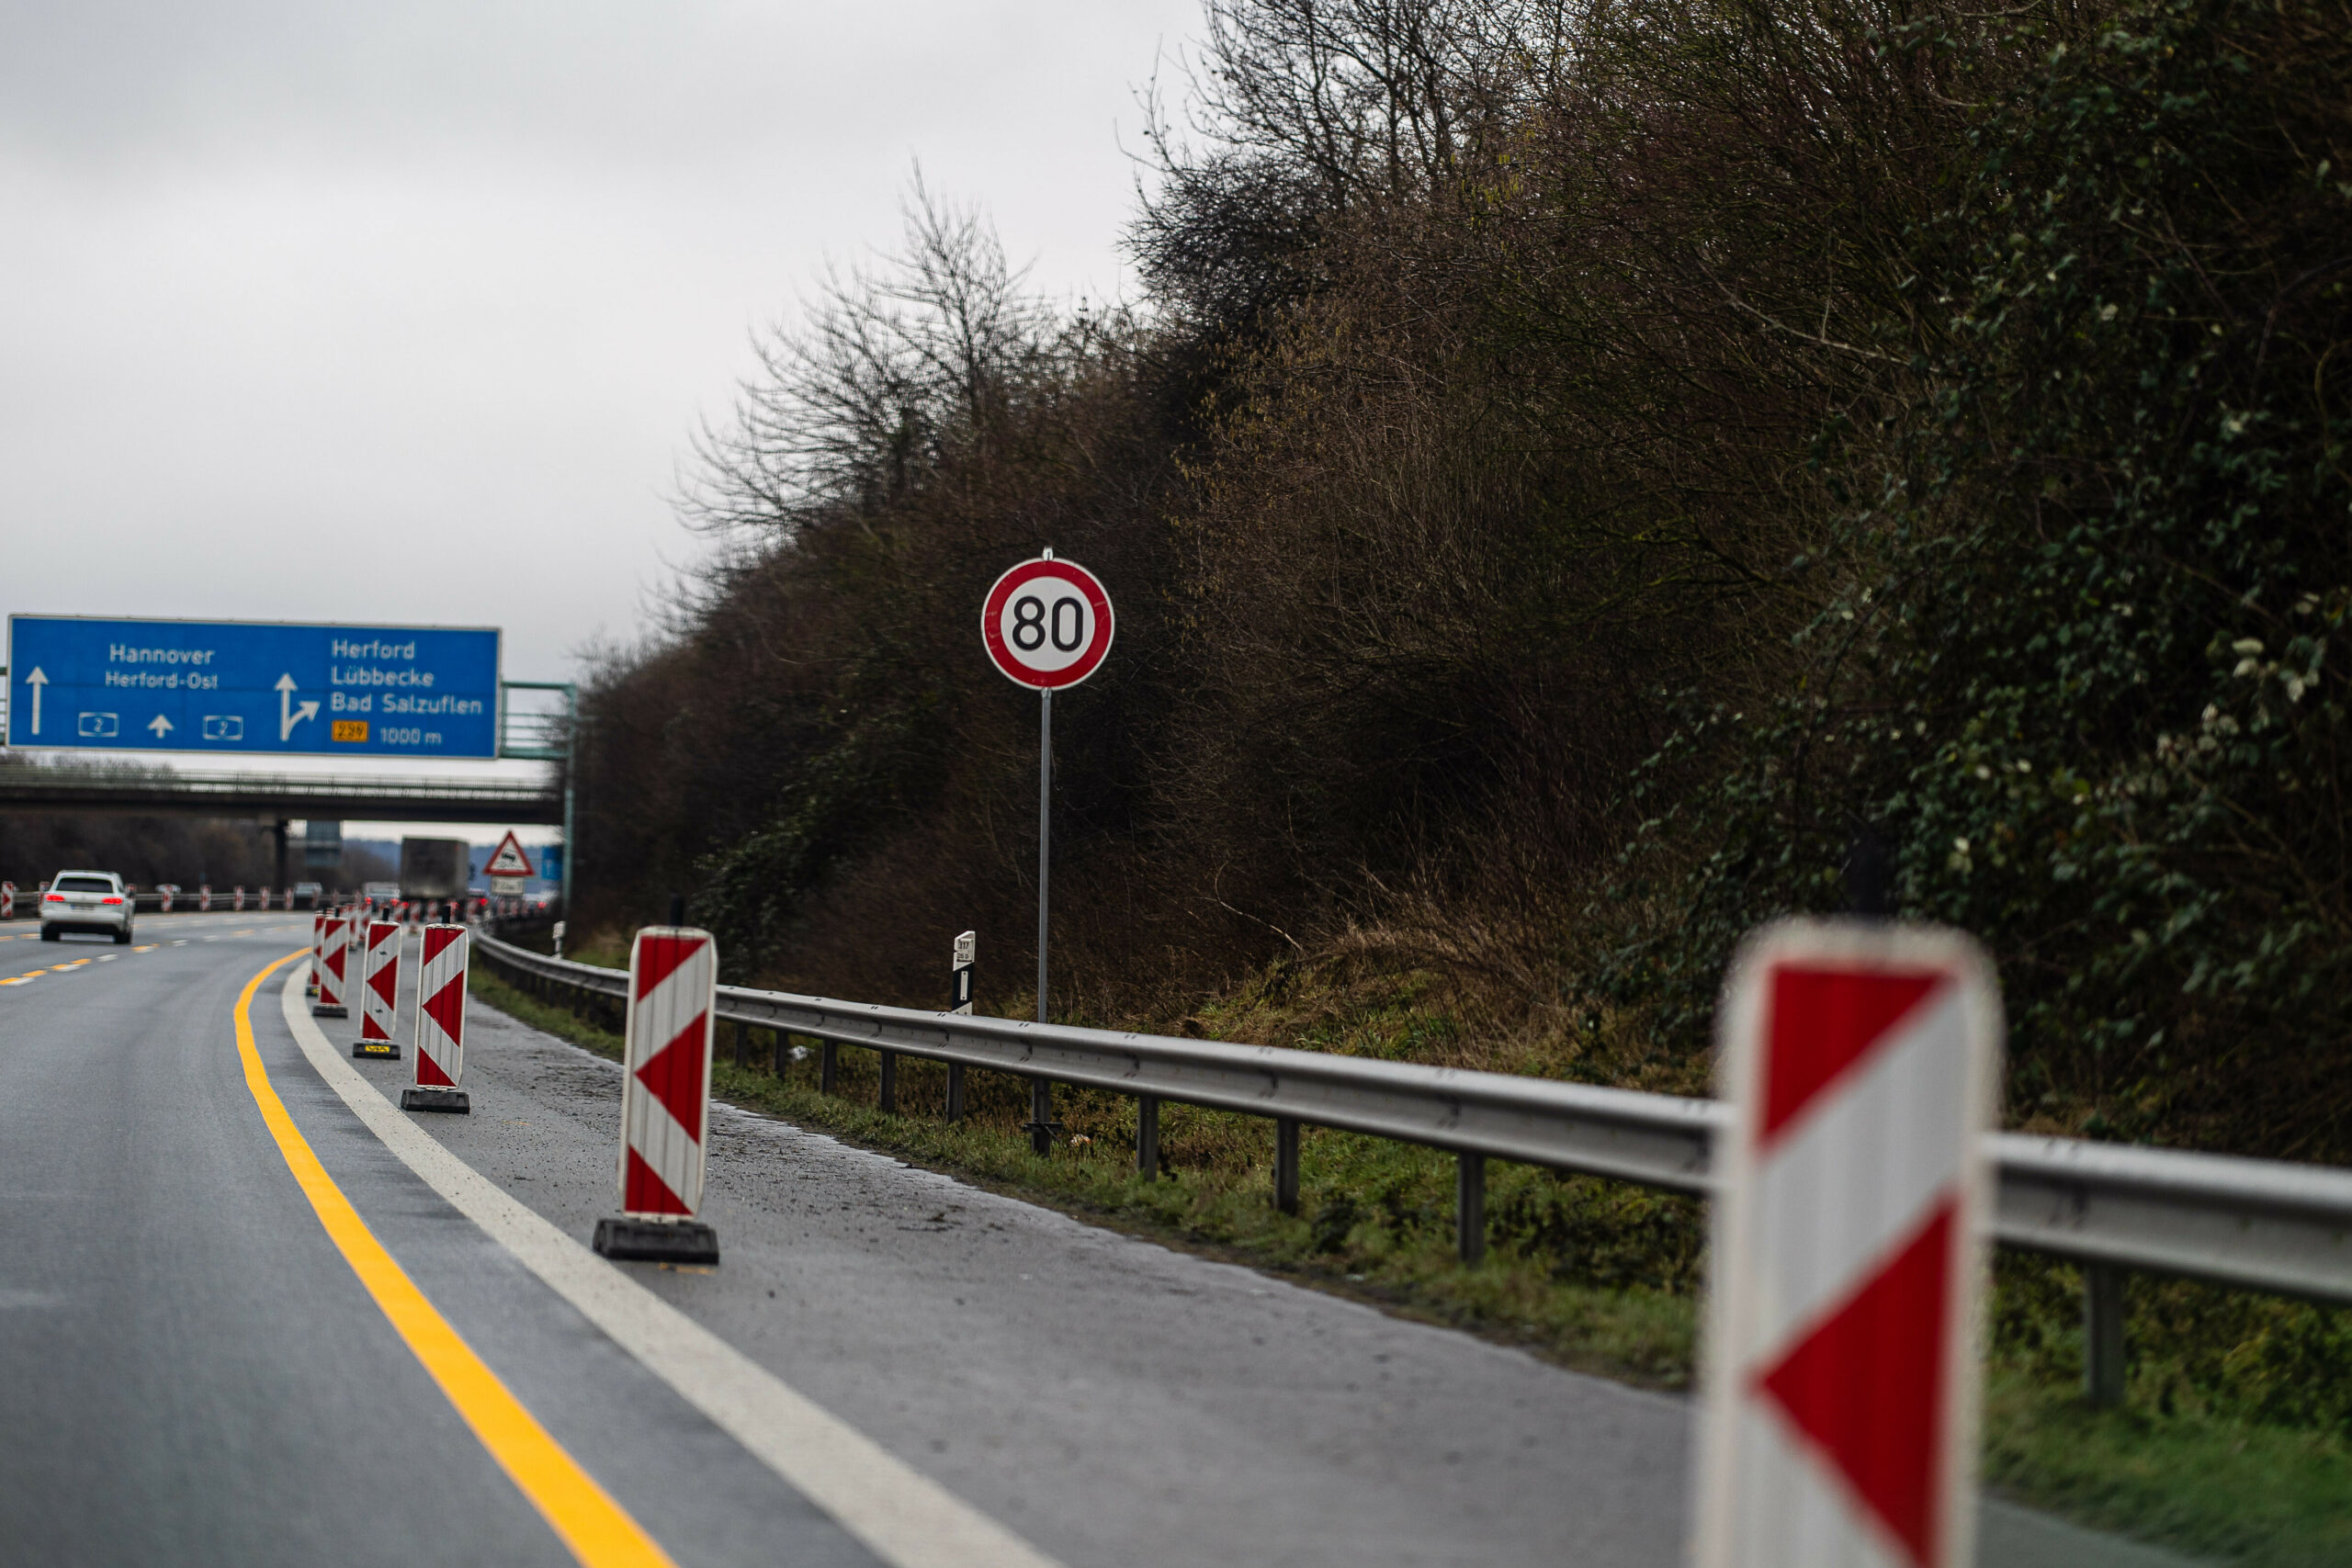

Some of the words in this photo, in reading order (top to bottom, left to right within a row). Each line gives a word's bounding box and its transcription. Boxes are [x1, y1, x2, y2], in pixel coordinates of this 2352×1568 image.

[1012, 595, 1084, 653] 80
[109, 643, 215, 664] Hannover
[332, 639, 416, 660] Herford
[105, 671, 219, 690] Herford-Ost
[332, 665, 435, 687] Lübbecke
[331, 692, 372, 713] Bad
[382, 693, 482, 716] Salzuflen
[94, 717, 103, 733] 2
[218, 721, 228, 737] 2
[380, 727, 421, 745] 1000
[425, 732, 442, 745] m
